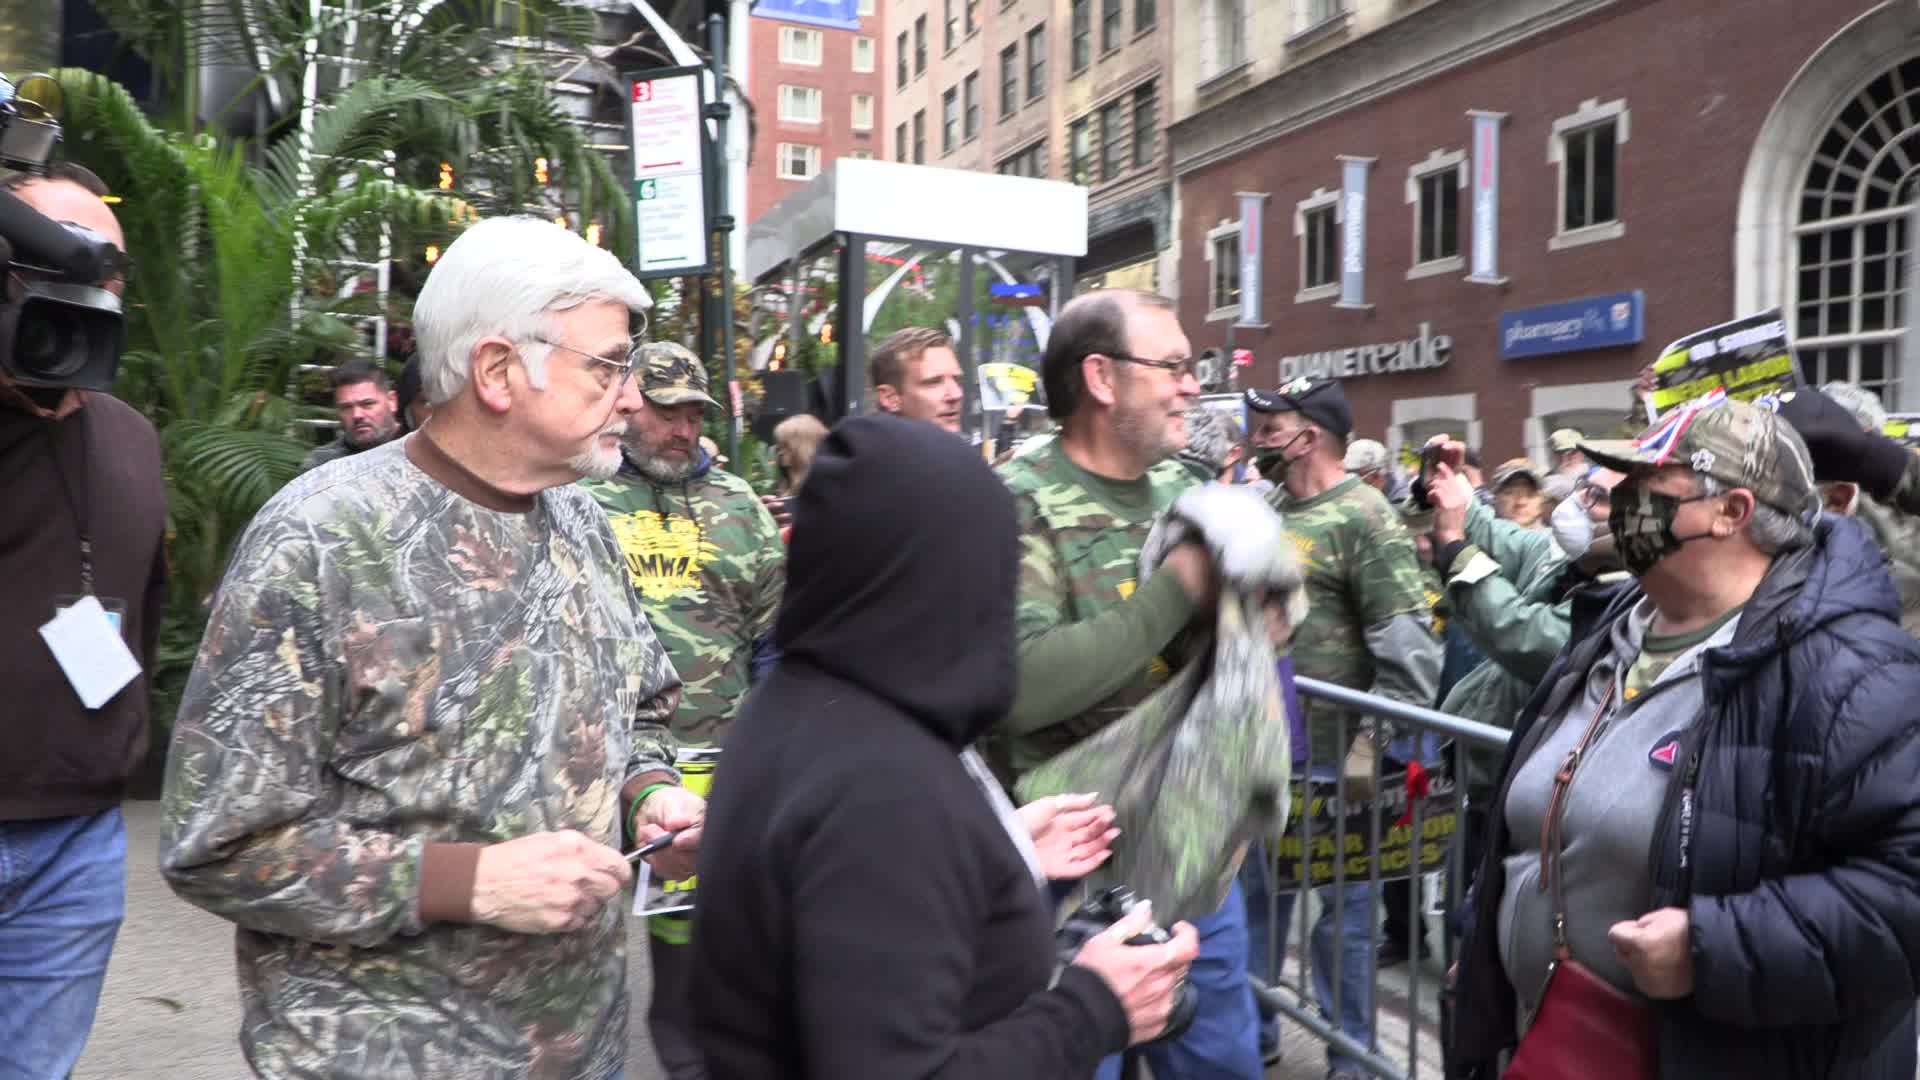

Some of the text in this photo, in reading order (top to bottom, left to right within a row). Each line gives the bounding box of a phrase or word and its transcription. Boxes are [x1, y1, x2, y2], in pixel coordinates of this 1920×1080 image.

[636, 81, 650, 101] 3
[640, 180, 656, 200] 6
[624, 552, 691, 577] UMWA
